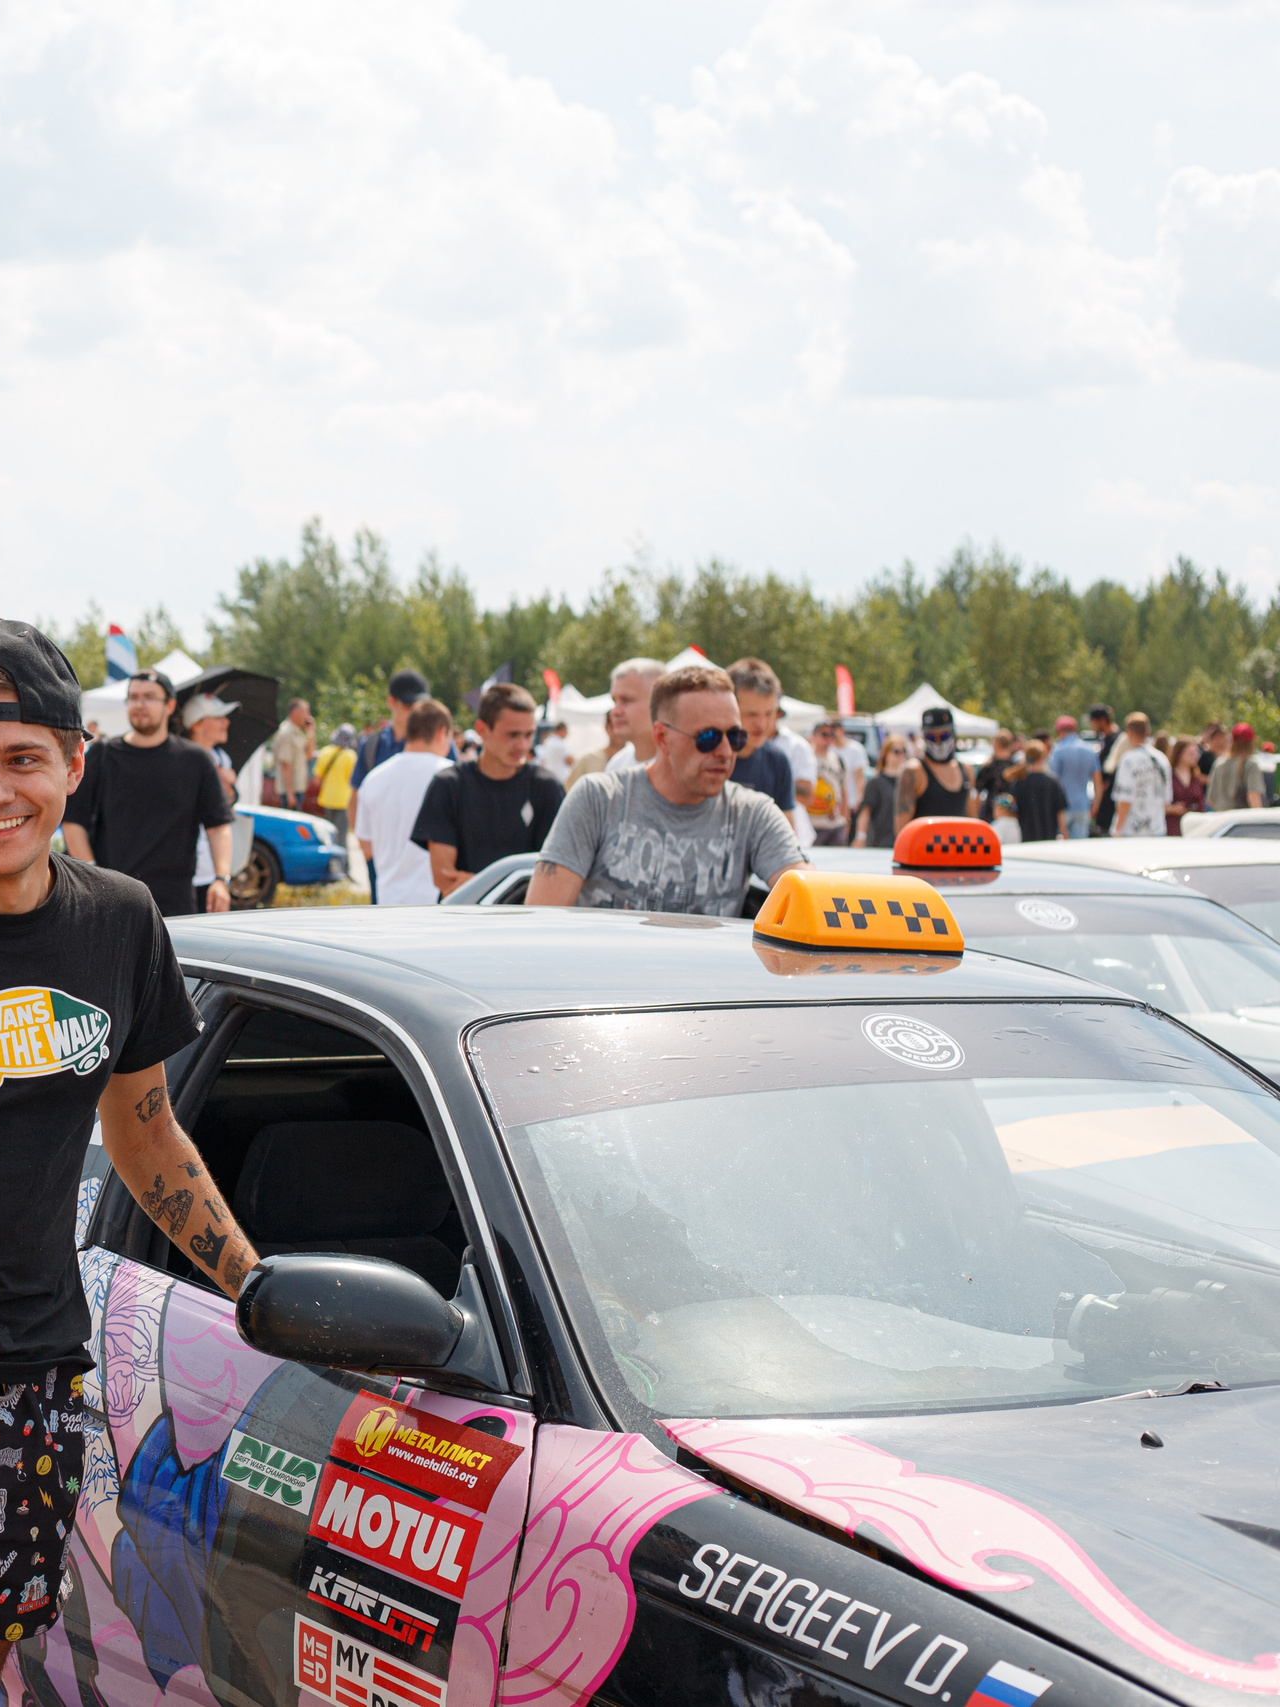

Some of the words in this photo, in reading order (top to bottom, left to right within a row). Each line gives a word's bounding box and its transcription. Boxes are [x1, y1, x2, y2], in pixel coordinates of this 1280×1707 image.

[43, 1011, 102, 1060] WALL"
[875, 1020, 893, 1036] PERM
[895, 1020, 933, 1035] AUTO
[901, 1049, 951, 1063] WEEKEND
[223, 1435, 317, 1506] DWC
[234, 1453, 251, 1465] DRIFT
[249, 1459, 266, 1473] WARS
[265, 1466, 306, 1488] CHAMPIONSHIP
[387, 1445, 478, 1489] www.metallist.org
[393, 1425, 493, 1471] МЕТАЛЛИСТ
[318, 1478, 466, 1583] MOTUL
[678, 1543, 921, 1671] SERGEEV
[904, 1634, 969, 1702] D.
[337, 1639, 370, 1678] MY
